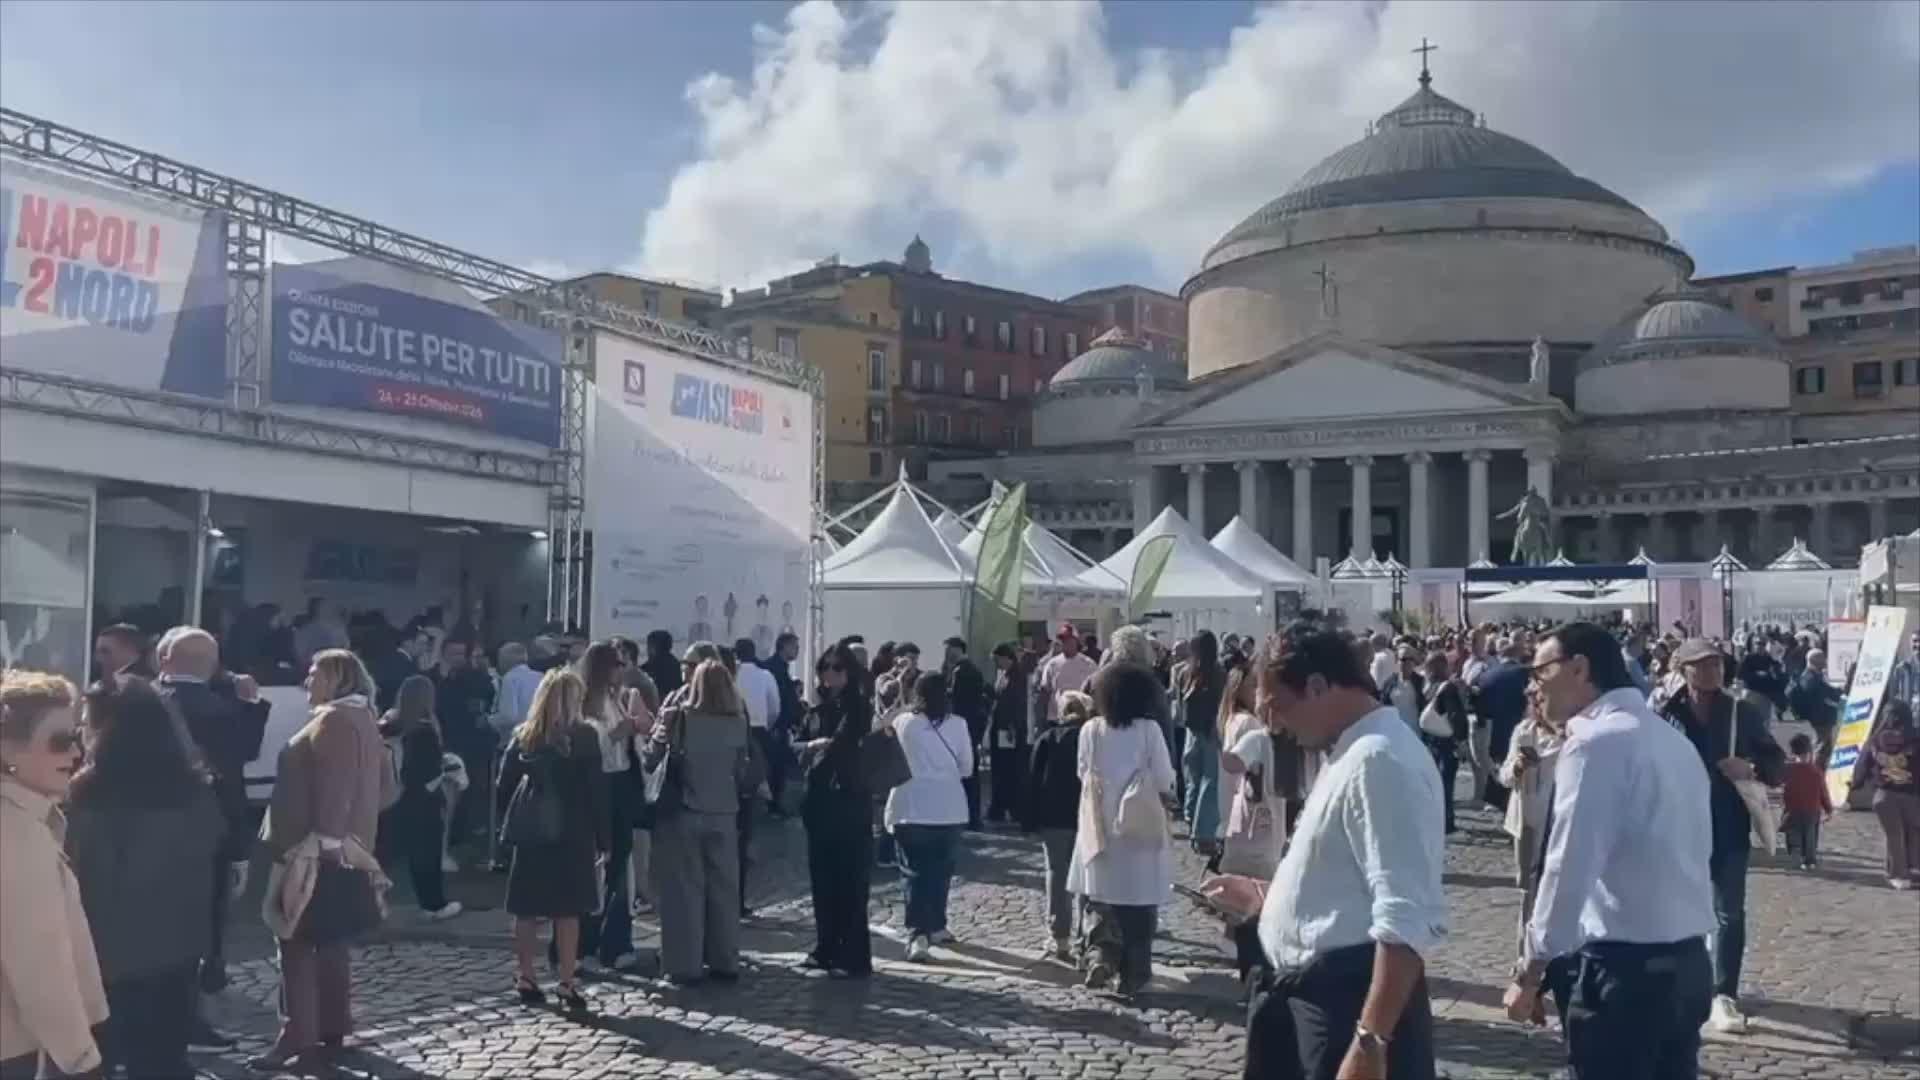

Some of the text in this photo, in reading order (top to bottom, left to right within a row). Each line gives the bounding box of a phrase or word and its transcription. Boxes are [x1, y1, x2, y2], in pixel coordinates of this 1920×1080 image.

[16, 194, 161, 277] NAPOLI
[288, 308, 417, 365] SALUTE
[422, 332, 475, 377] PER
[479, 348, 551, 395] TUTTI
